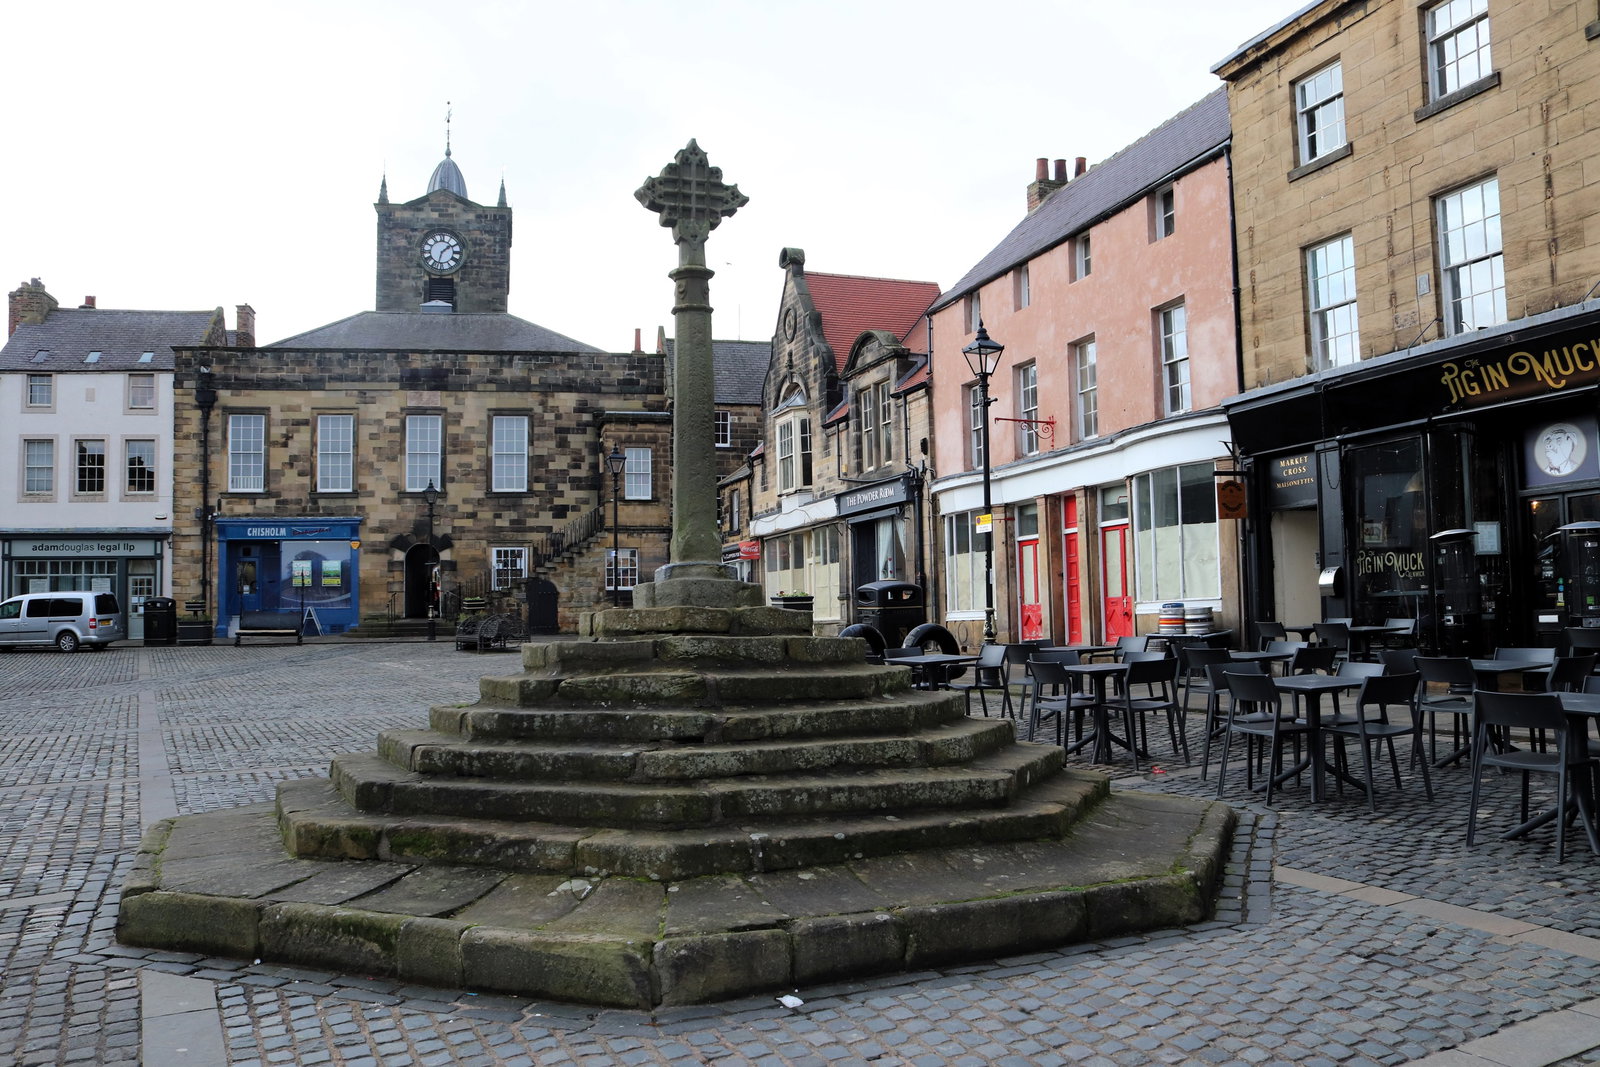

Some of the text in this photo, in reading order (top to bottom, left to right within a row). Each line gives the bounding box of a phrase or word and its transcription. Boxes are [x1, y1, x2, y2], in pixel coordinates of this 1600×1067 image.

[1440, 362, 1482, 404] PIG
[1479, 362, 1510, 392] IN
[1279, 455, 1308, 467] MARKET
[1283, 465, 1307, 476] CROSS
[846, 486, 895, 507] THE POWDER ROOM
[247, 527, 287, 537] CHISHOLM
[97, 543, 120, 553] legal
[123, 543, 135, 553] llp
[1356, 550, 1425, 578] PIG IN MUCK
